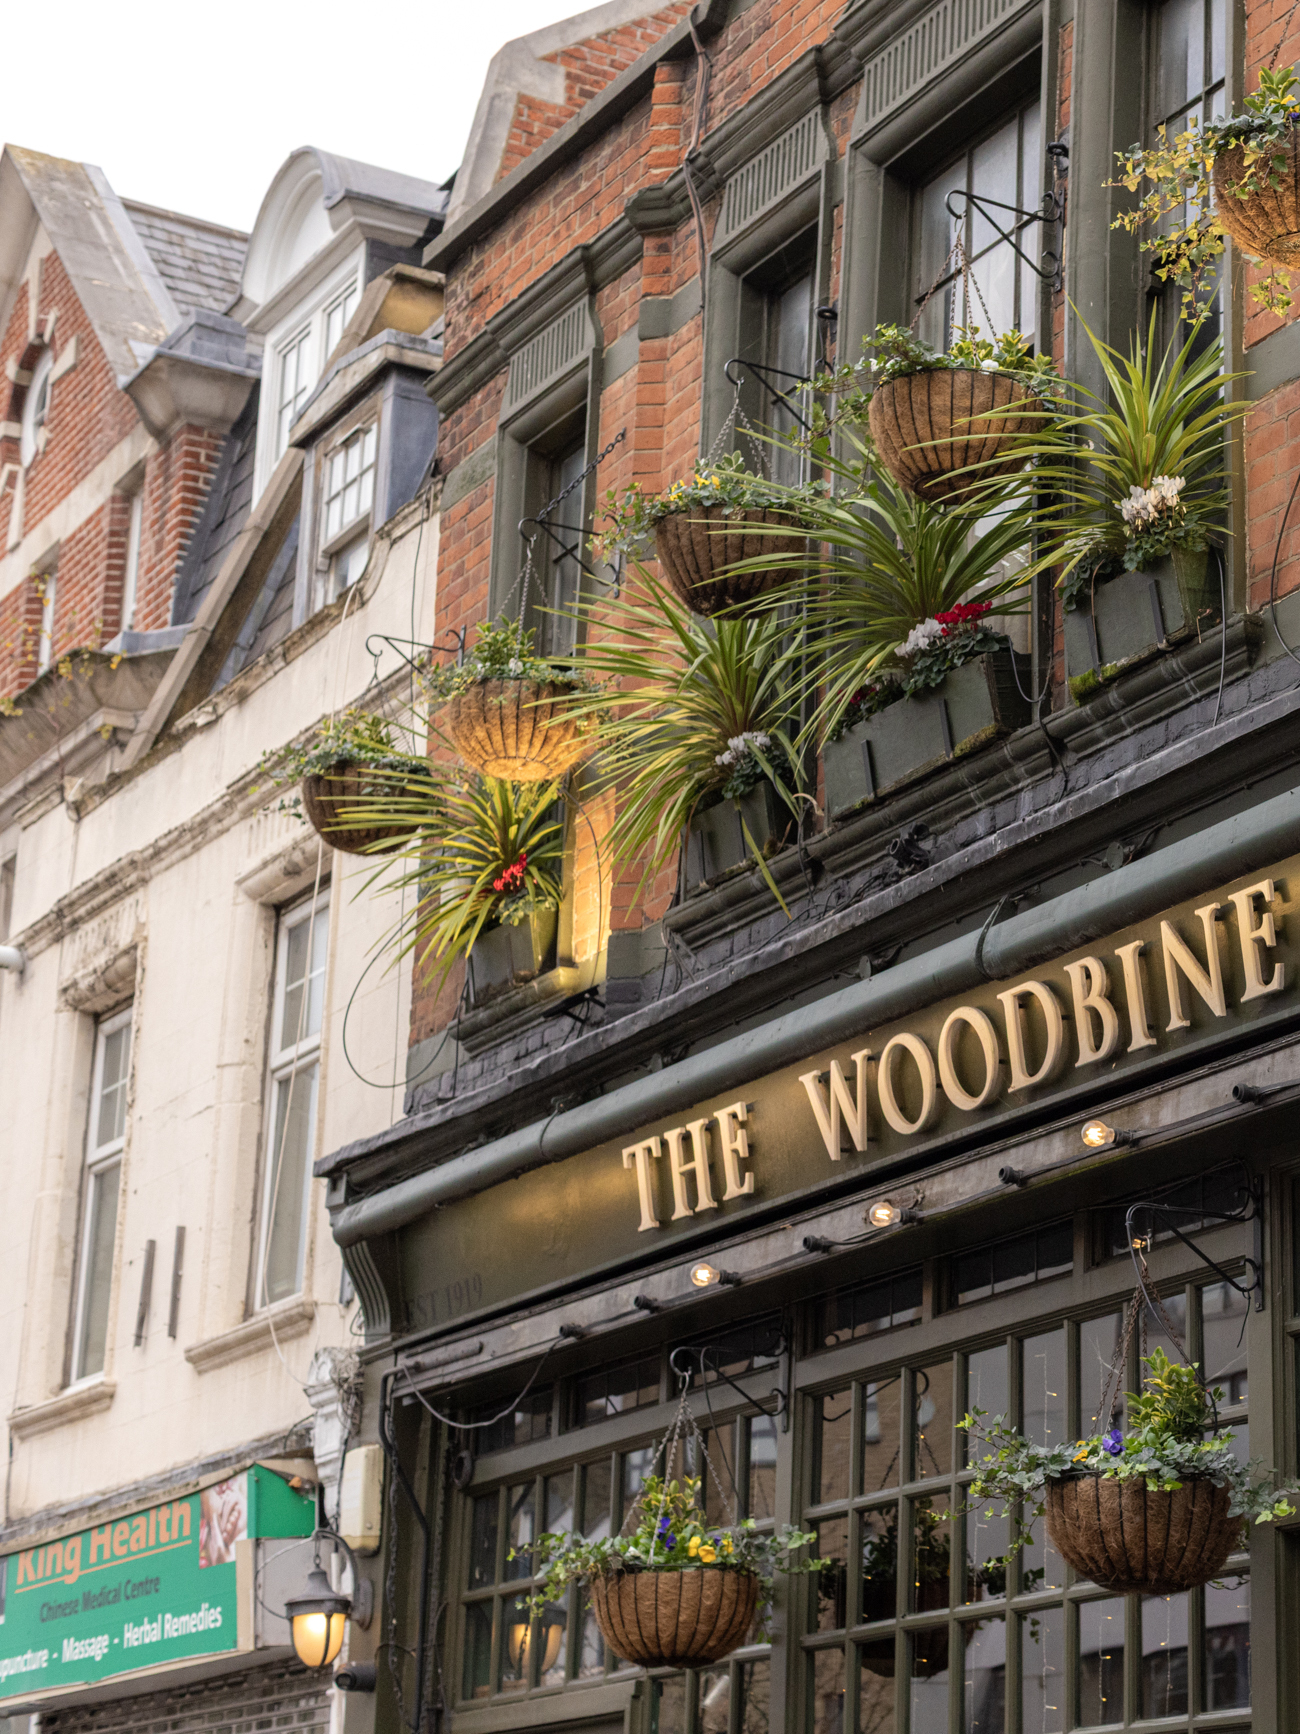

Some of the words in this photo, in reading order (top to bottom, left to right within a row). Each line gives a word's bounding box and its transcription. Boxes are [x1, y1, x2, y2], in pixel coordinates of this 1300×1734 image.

[621, 1101, 755, 1232] THE
[798, 878, 1286, 1162] WOODBINE
[444, 1272, 483, 1317] 1919
[16, 1536, 83, 1585] King
[89, 1500, 192, 1564] Health
[40, 1596, 79, 1623] Chinese
[81, 1582, 122, 1612] Medical
[124, 1576, 161, 1601] Centre
[0, 1647, 49, 1684] puncture
[62, 1633, 110, 1662] Massage
[123, 1613, 162, 1649] Herbal
[163, 1603, 223, 1639] Remedies
